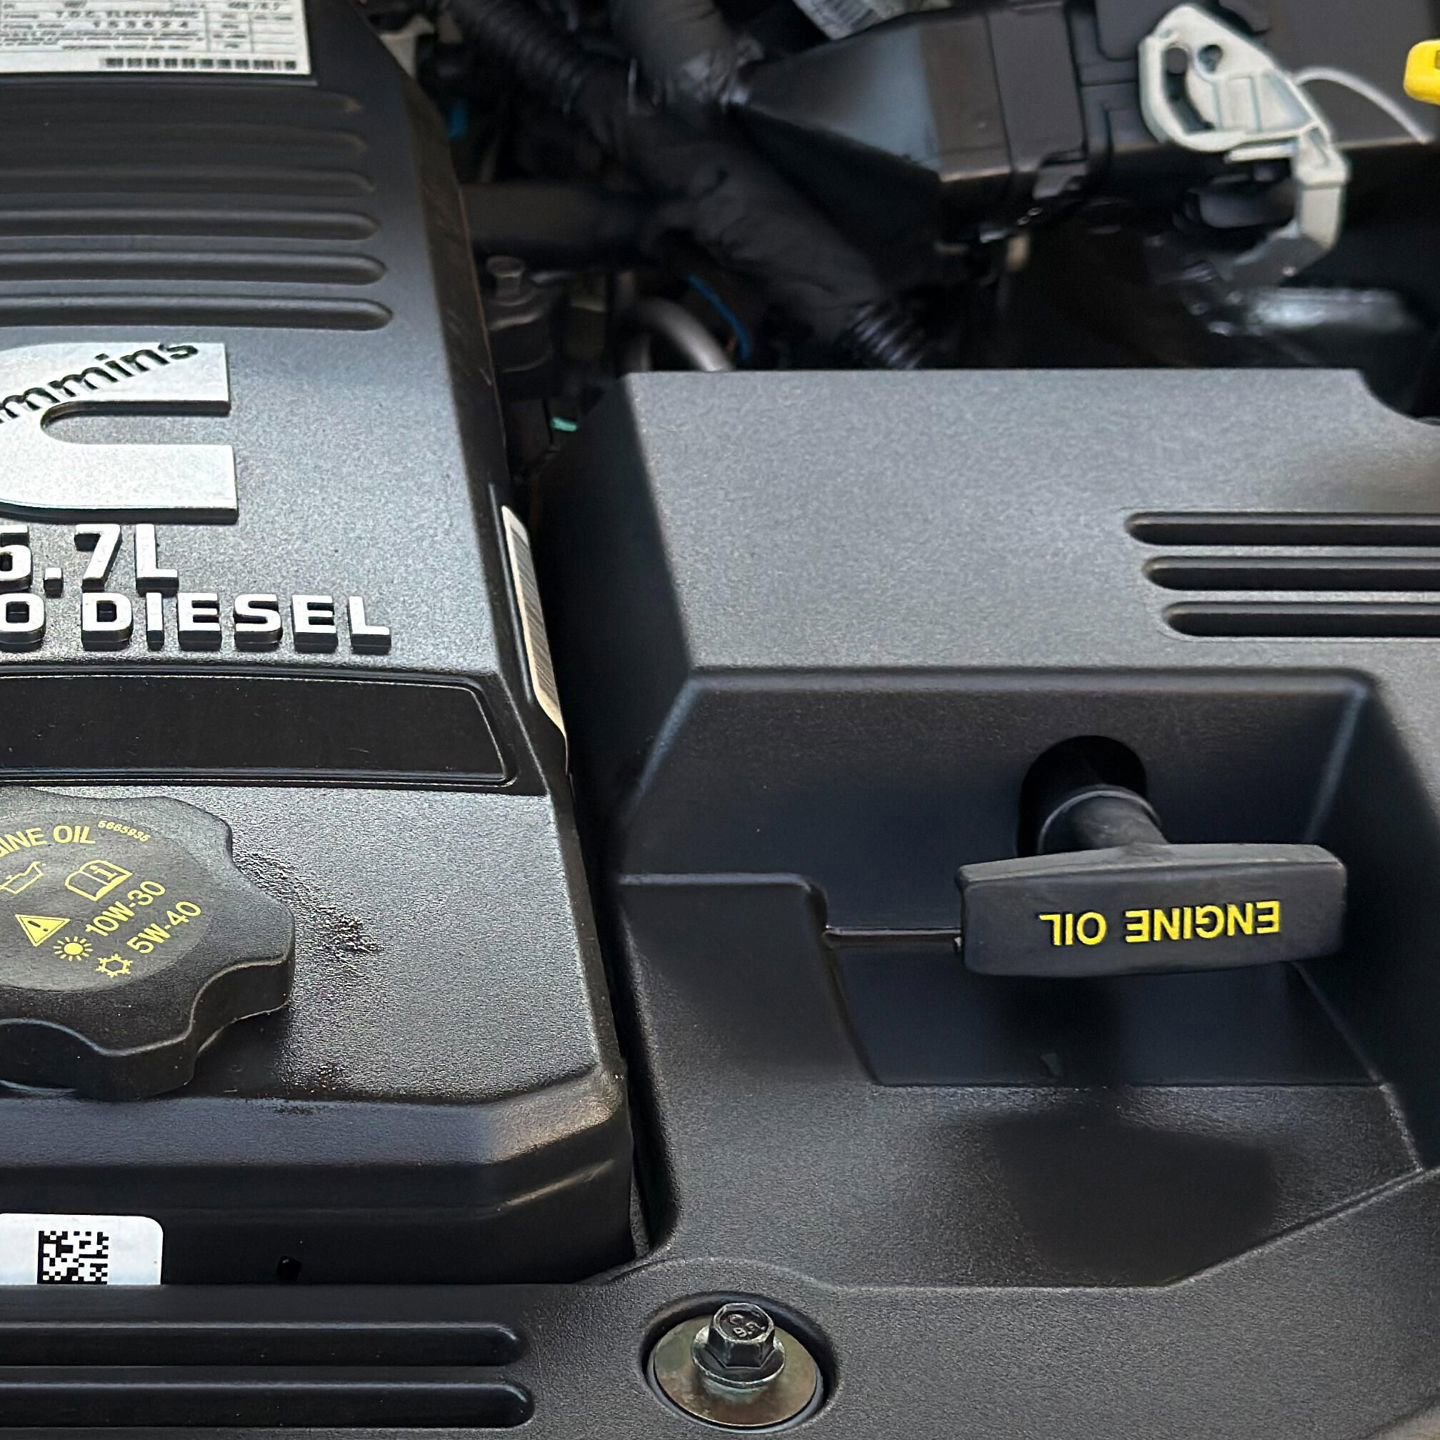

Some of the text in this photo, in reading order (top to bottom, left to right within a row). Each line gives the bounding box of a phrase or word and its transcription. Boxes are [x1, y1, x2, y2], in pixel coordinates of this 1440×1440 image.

[81, 590, 392, 652] DIESEL
[52, 824, 97, 845] OIL
[83, 879, 167, 937] 10W-30
[126, 899, 202, 956] 5W-40
[1038, 900, 1280, 947] ENGINE OIL
